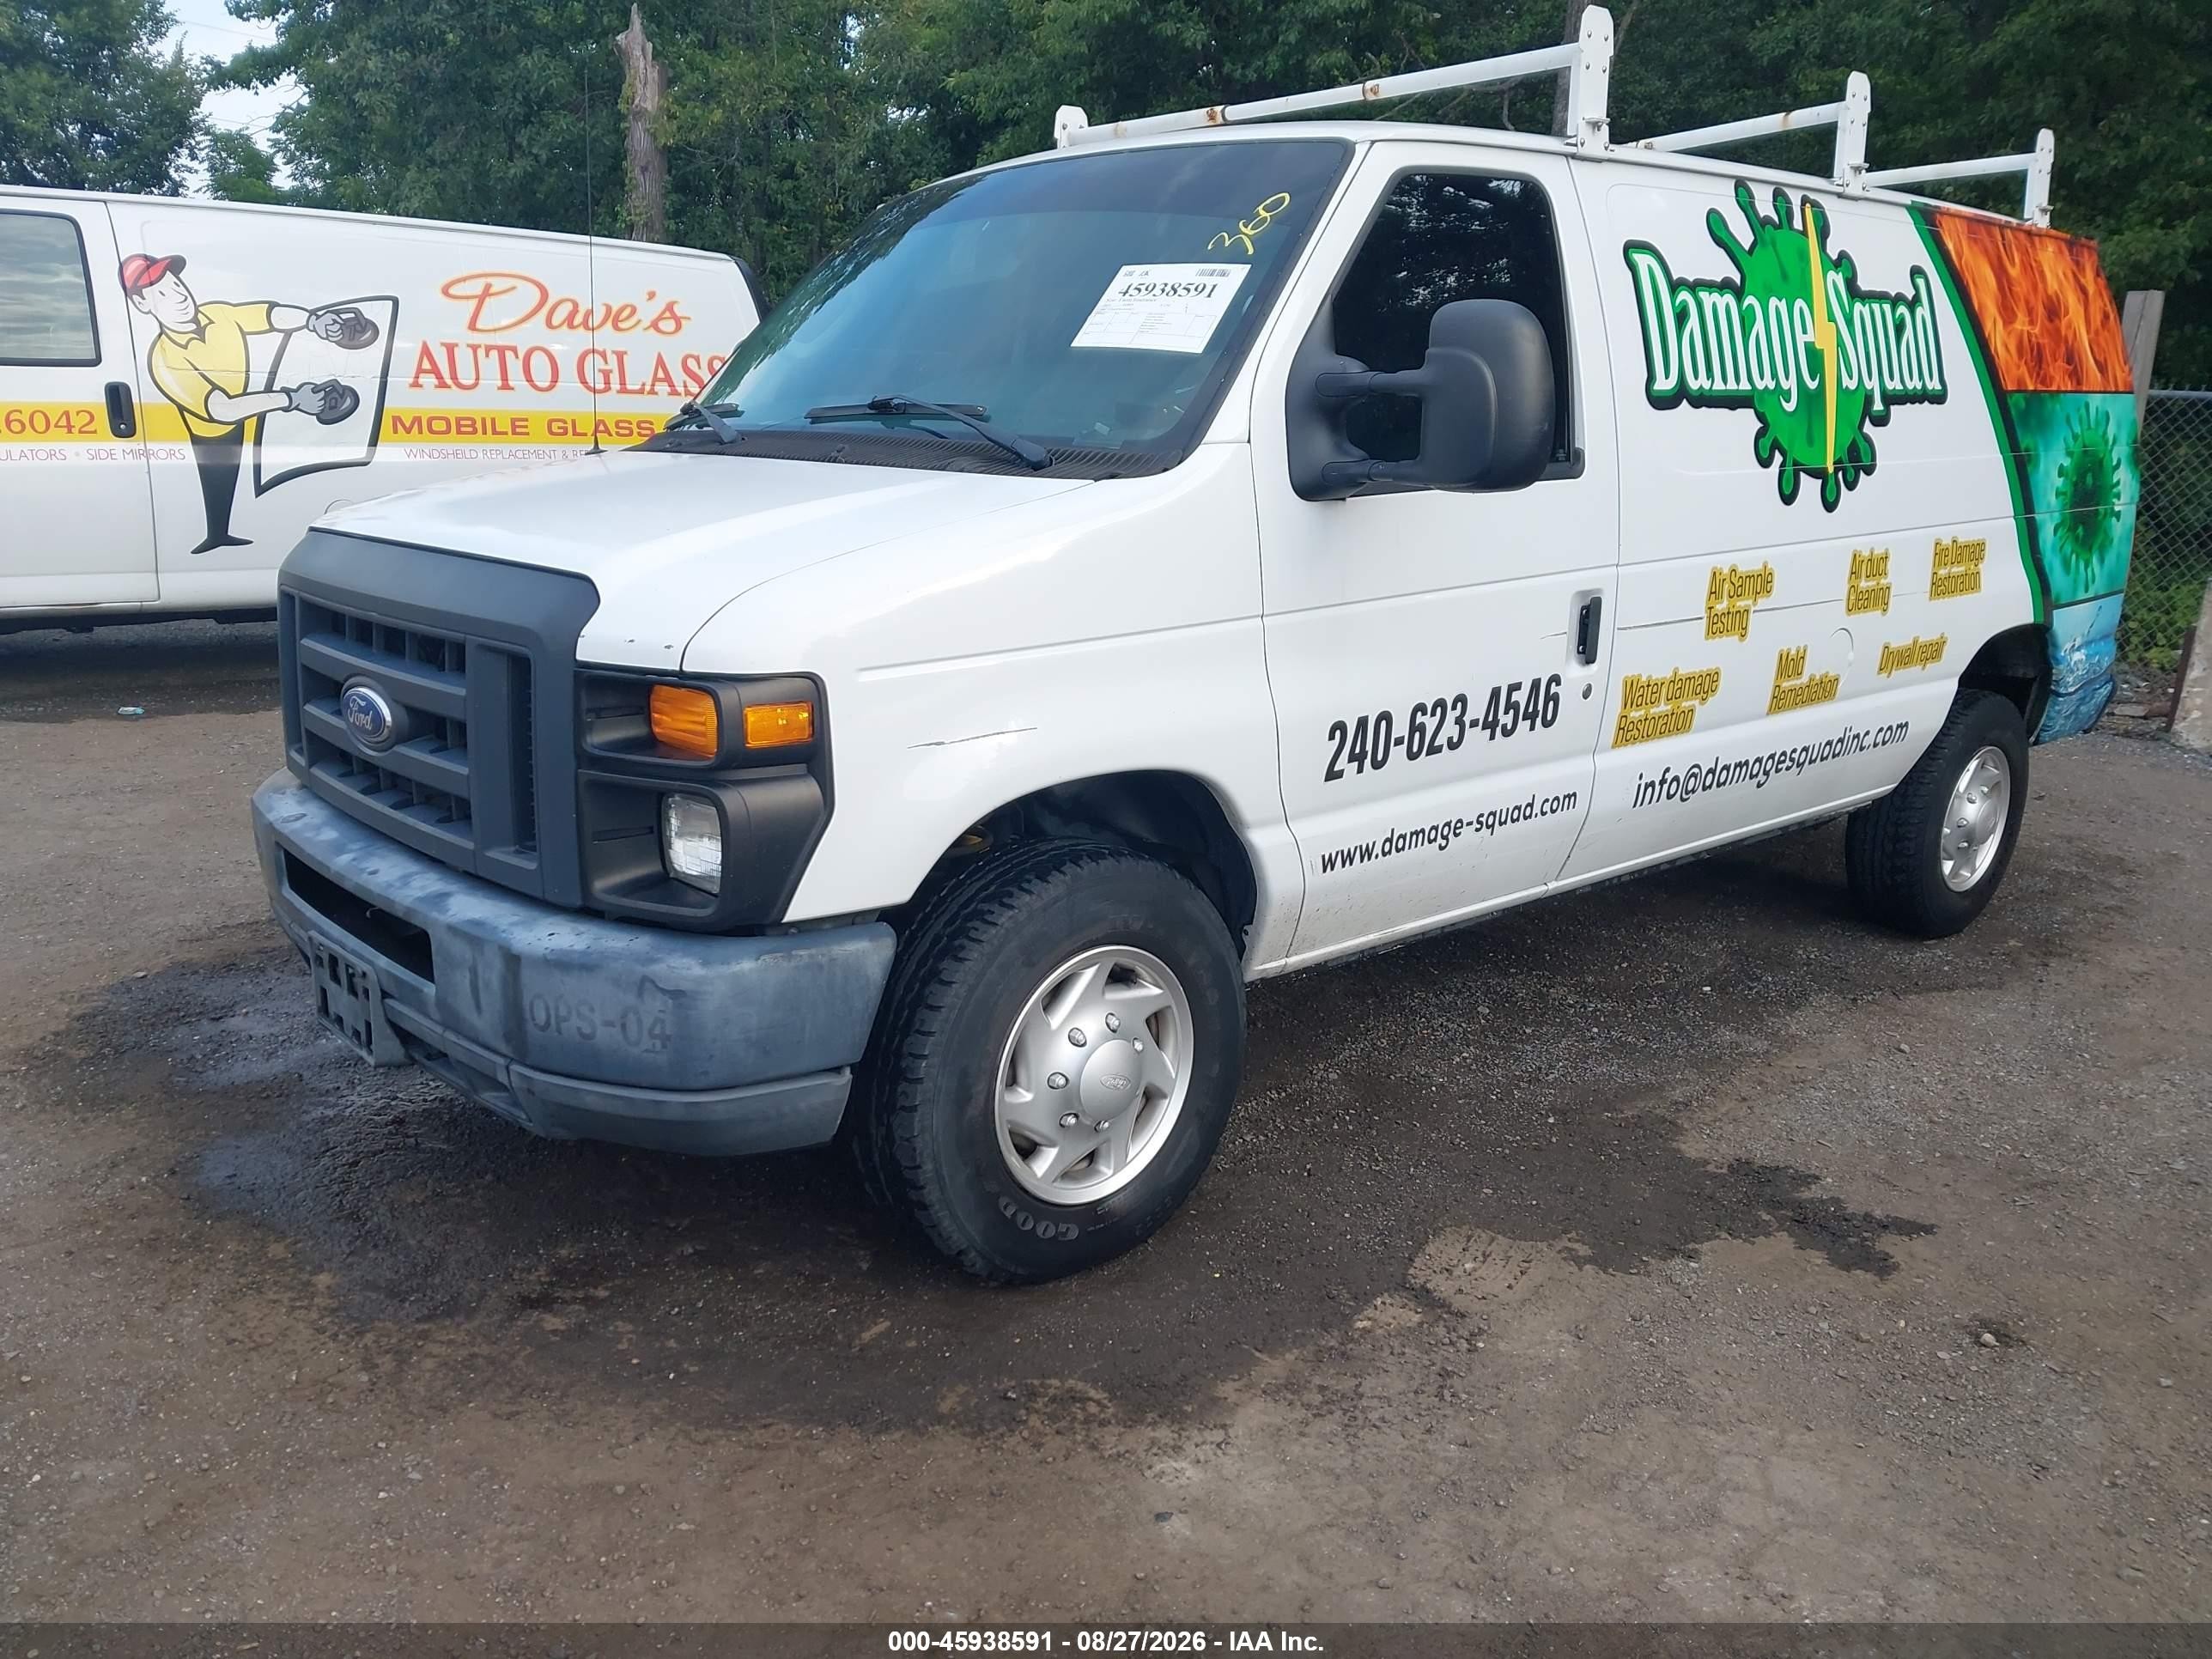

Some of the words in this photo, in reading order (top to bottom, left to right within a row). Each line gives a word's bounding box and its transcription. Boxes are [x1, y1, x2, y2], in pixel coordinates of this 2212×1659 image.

[441, 272, 692, 335] Dave's
[1118, 283, 1218, 298] 45938591
[1632, 252, 1820, 412] Damage
[1826, 270, 1942, 411] Squad
[410, 341, 560, 392] AUTO
[391, 416, 530, 437] MOBILE
[547, 418, 656, 438] GLASS
[86, 448, 118, 461] SIDE
[123, 448, 186, 461] MIRRORS
[482, 448, 556, 460] REPLACEMENT
[561, 449, 569, 459] &
[1850, 552, 1865, 581] Air
[1865, 550, 1889, 579] duct
[1933, 542, 1949, 569] Fire
[1950, 539, 1986, 568] Damage
[1708, 570, 1727, 602] Air
[1728, 565, 1773, 602] Sample
[1847, 582, 1891, 612] Cleaning
[1931, 568, 1981, 598] Restoration
[1707, 605, 1749, 638] Testing
[1776, 648, 1807, 681] Mold
[1880, 640, 1917, 677] Drywall
[1917, 635, 1947, 669] repair
[1624, 678, 1666, 710] Water
[1666, 672, 1720, 702] damage
[1770, 674, 1839, 713] Remediation
[348, 696, 373, 730] Ford
[1324, 673, 1562, 782] 240-623-4546
[1614, 706, 1695, 745] Restoration
[1632, 719, 1910, 808] info@damagesquadinc.com
[1321, 791, 1577, 874] www.damage-squad.com
